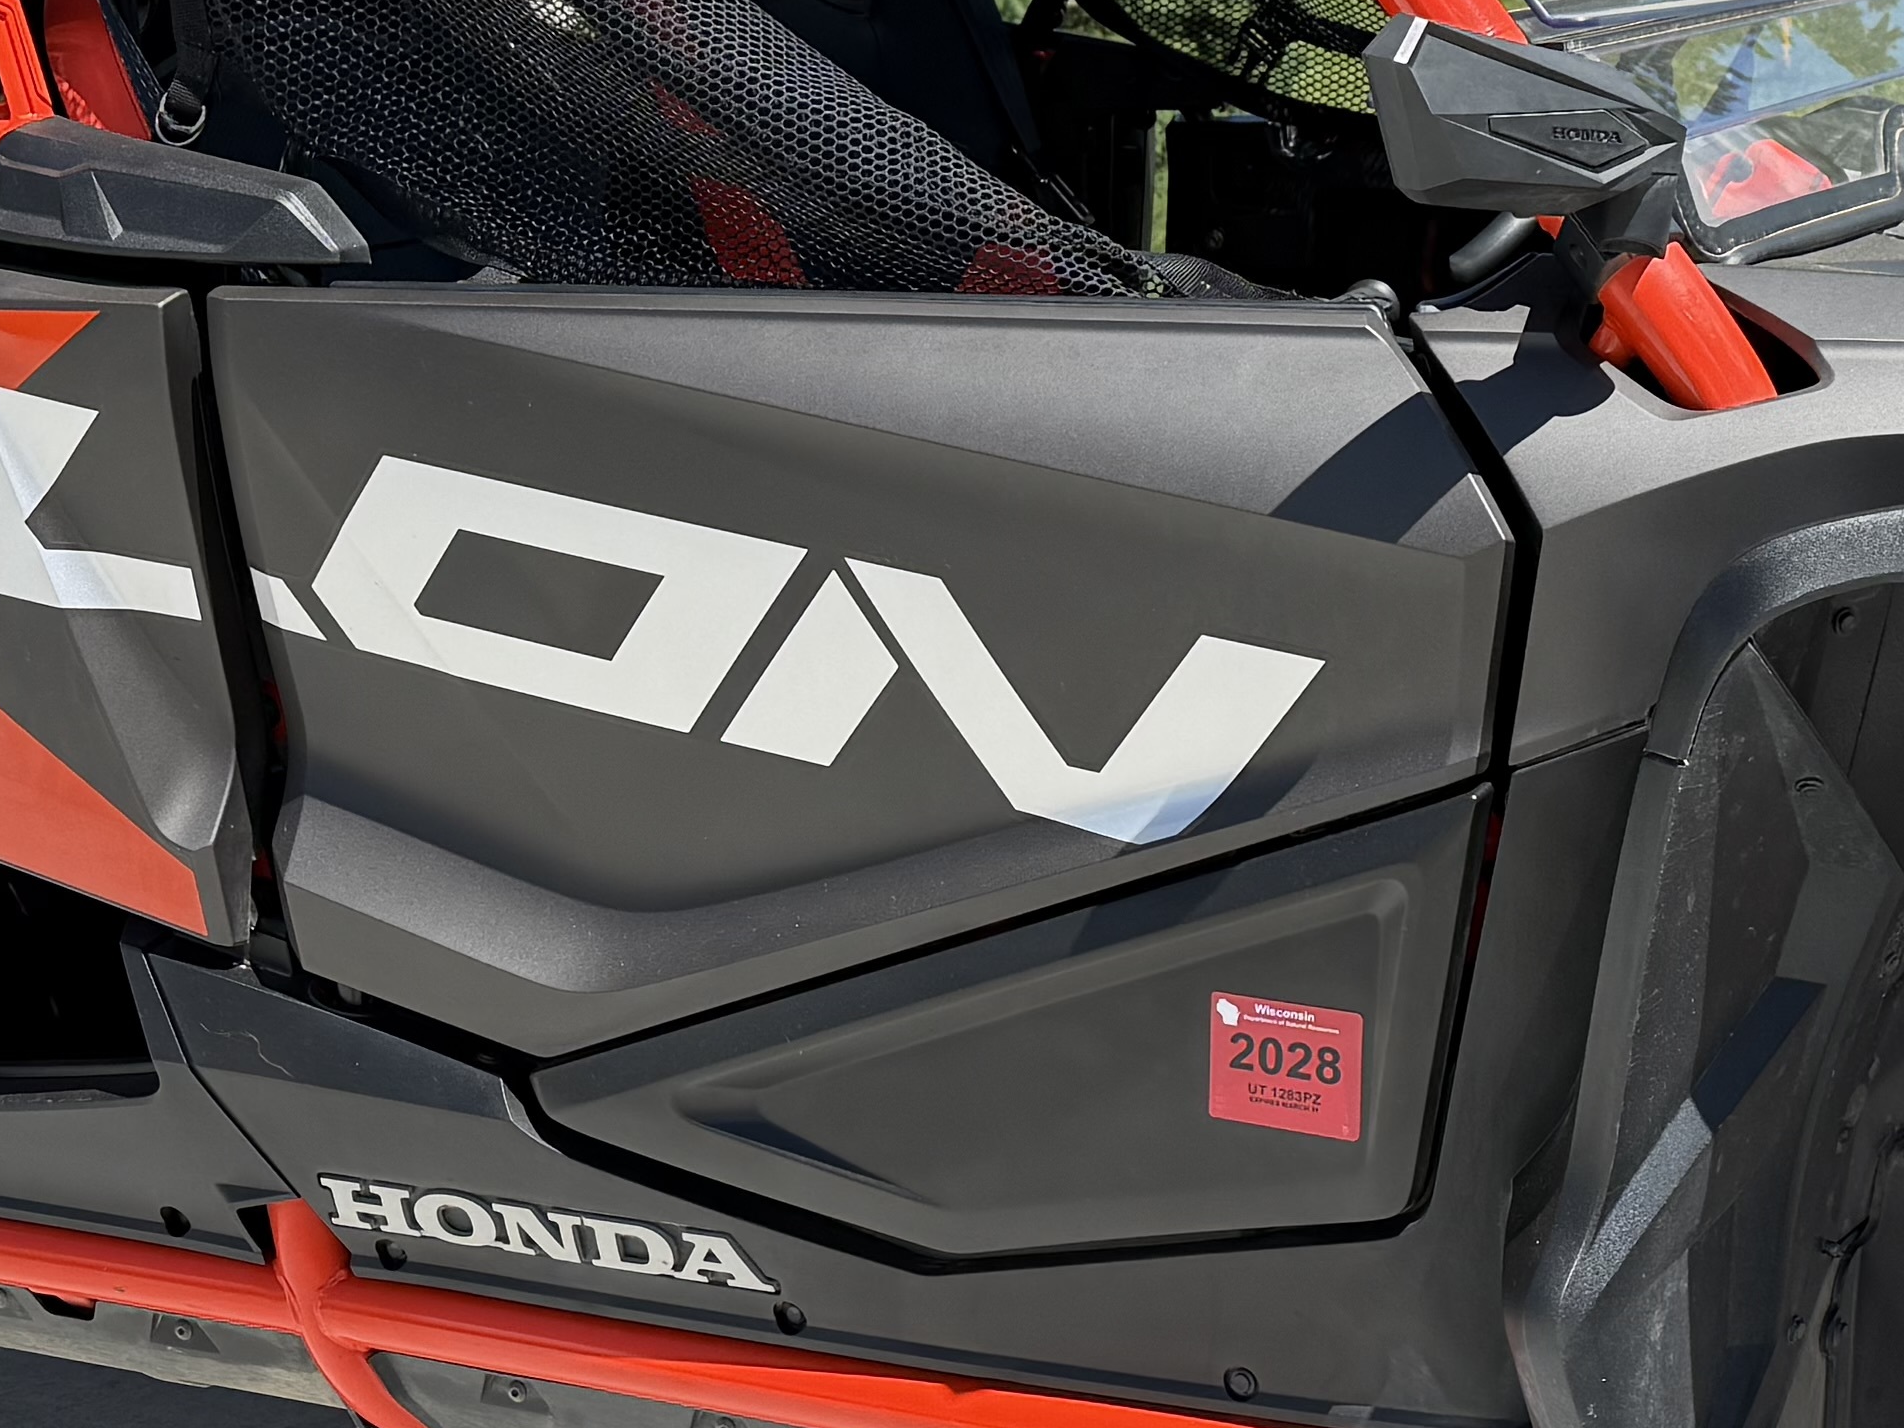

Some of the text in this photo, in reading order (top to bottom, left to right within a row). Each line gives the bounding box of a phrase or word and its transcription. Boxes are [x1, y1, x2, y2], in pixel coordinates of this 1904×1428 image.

[1551, 125, 1623, 144] HONDA
[1254, 1002, 1315, 1023] Wisconsin
[1228, 1032, 1343, 1085] 2028
[1248, 1083, 1322, 1106] UT 1283PZ
[318, 1172, 781, 1295] HONDA
